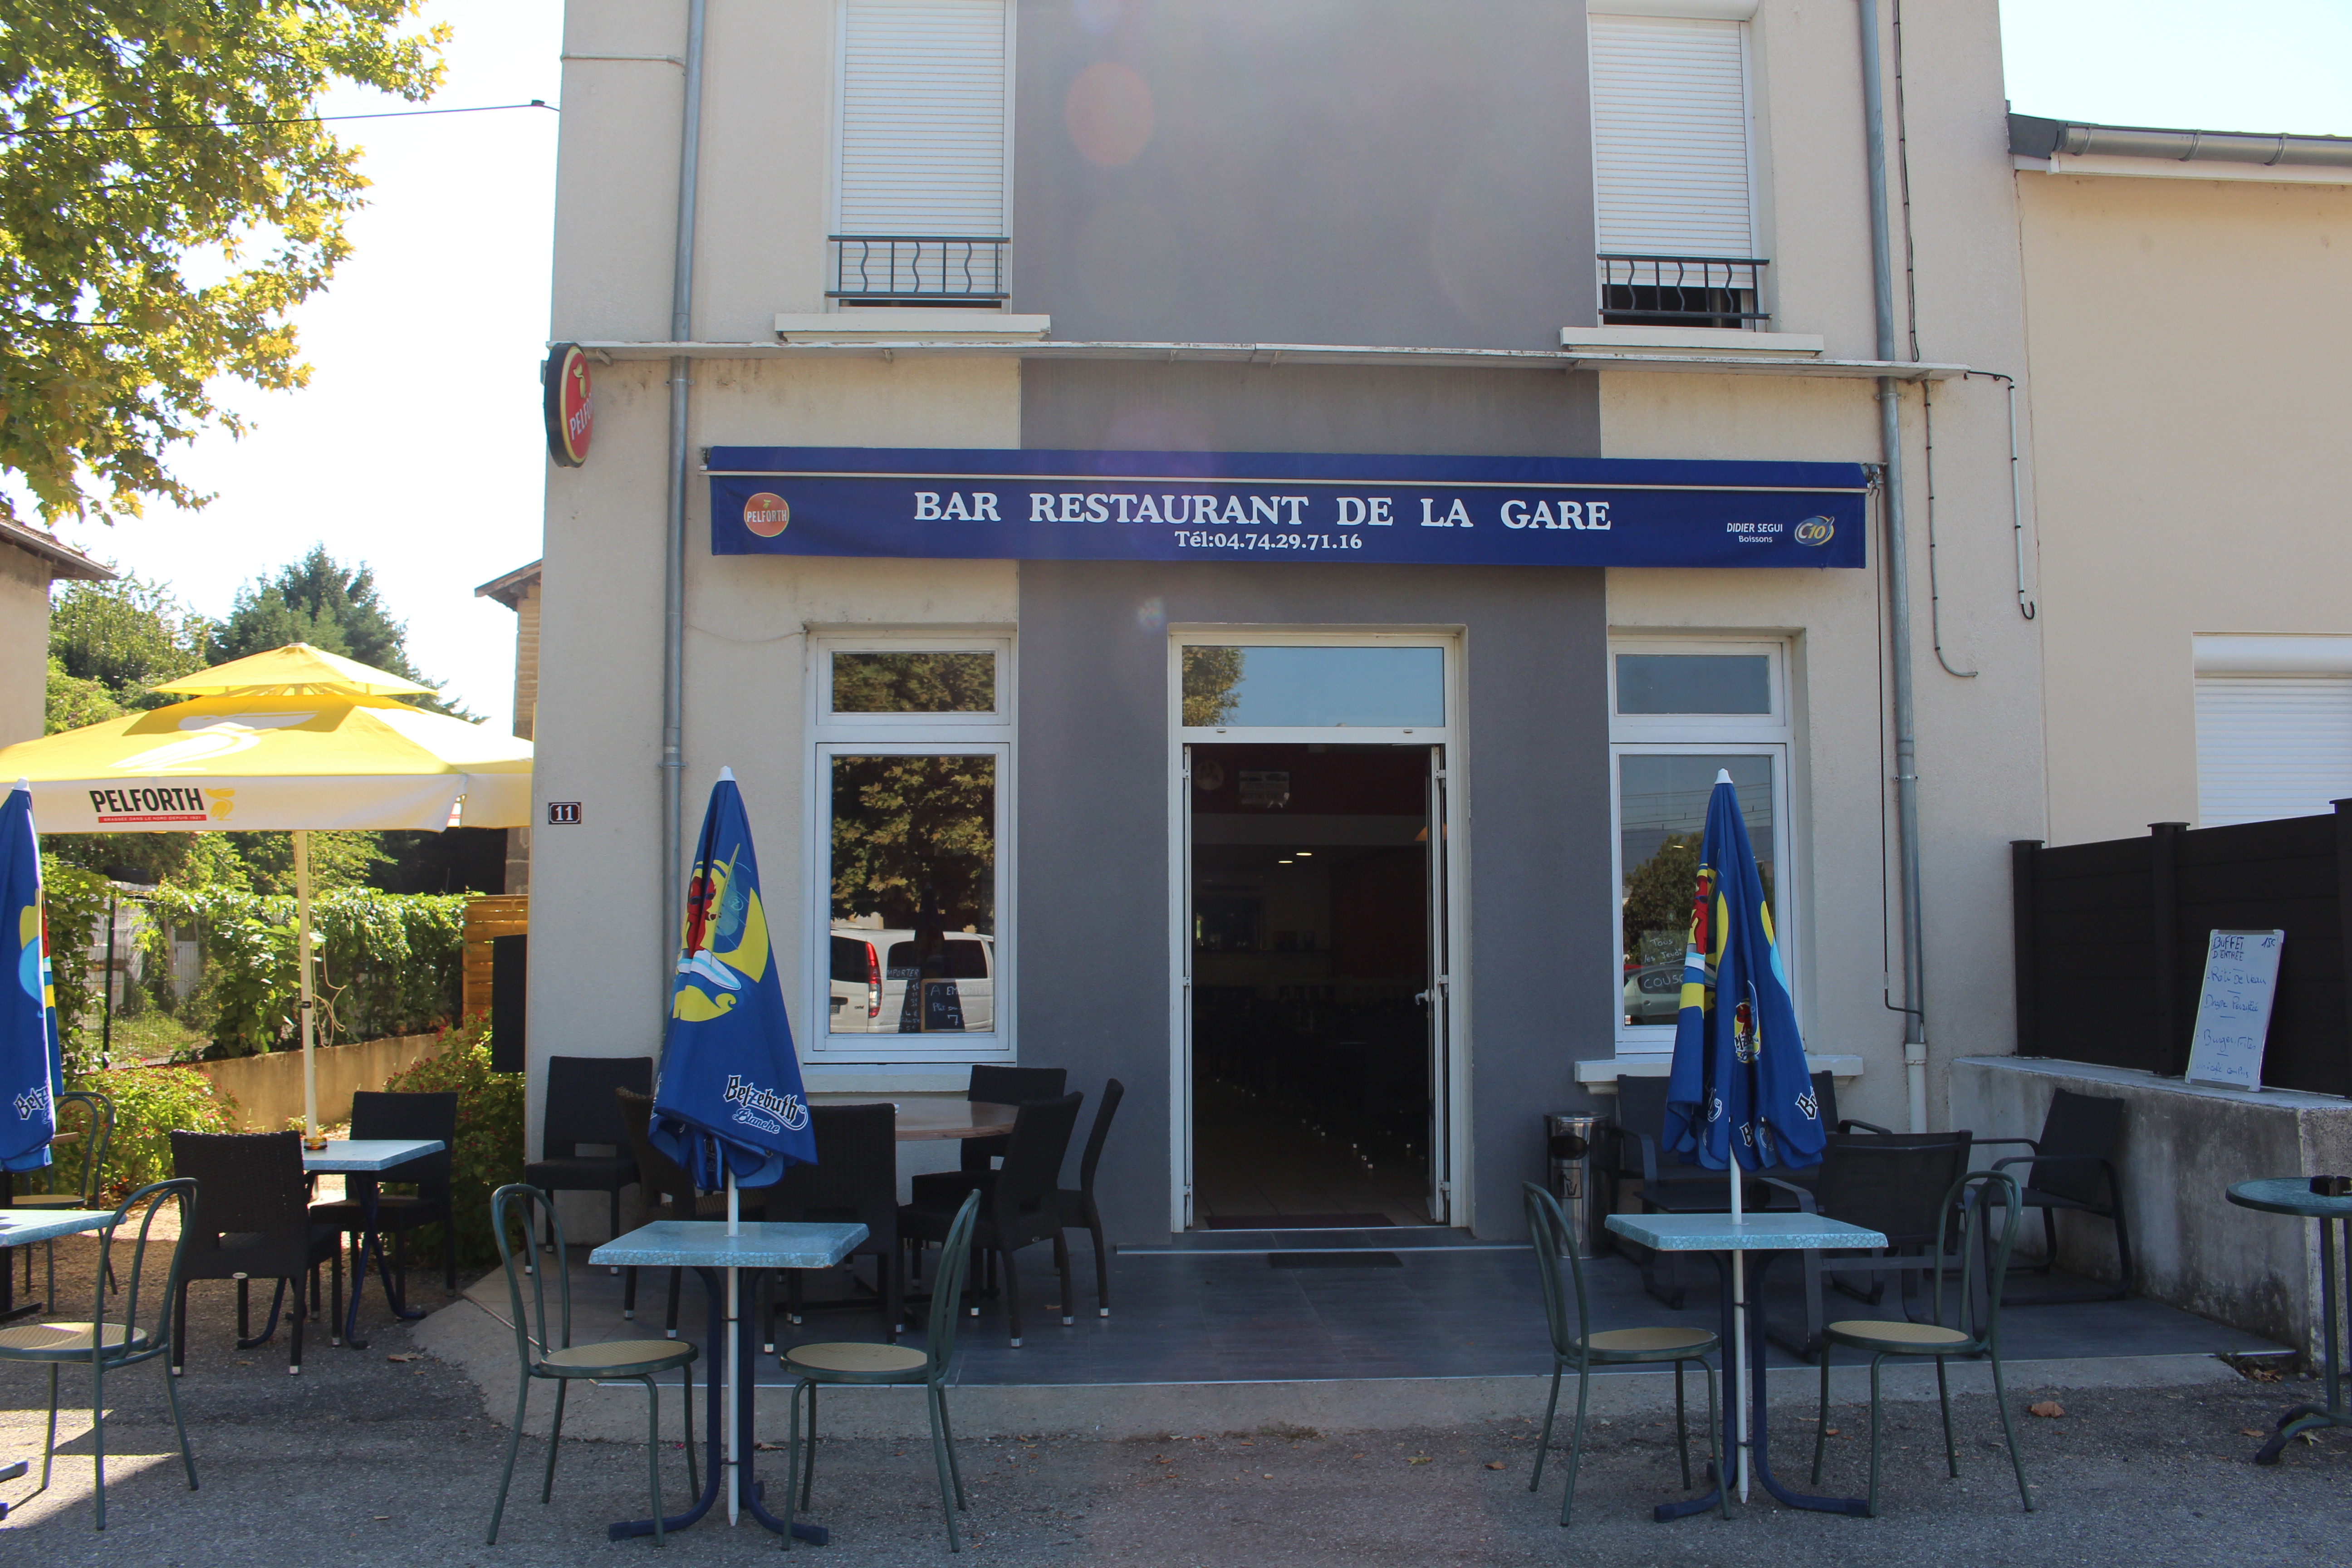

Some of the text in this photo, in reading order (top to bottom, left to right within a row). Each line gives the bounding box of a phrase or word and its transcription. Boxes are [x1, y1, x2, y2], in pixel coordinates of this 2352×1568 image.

[746, 510, 787, 522] PELFORTH
[914, 491, 1611, 530] BAR RESTAURANT DE LA GARE
[1727, 523, 1783, 533] DIDIER SEGUI
[88, 788, 205, 812] PELFORTH
[555, 806, 573, 820] 11
[1650, 938, 1673, 947] Tous
[1644, 974, 1683, 989] COUSC
[723, 1074, 799, 1125] Belzebuth
[732, 1108, 780, 1134] Blanche
